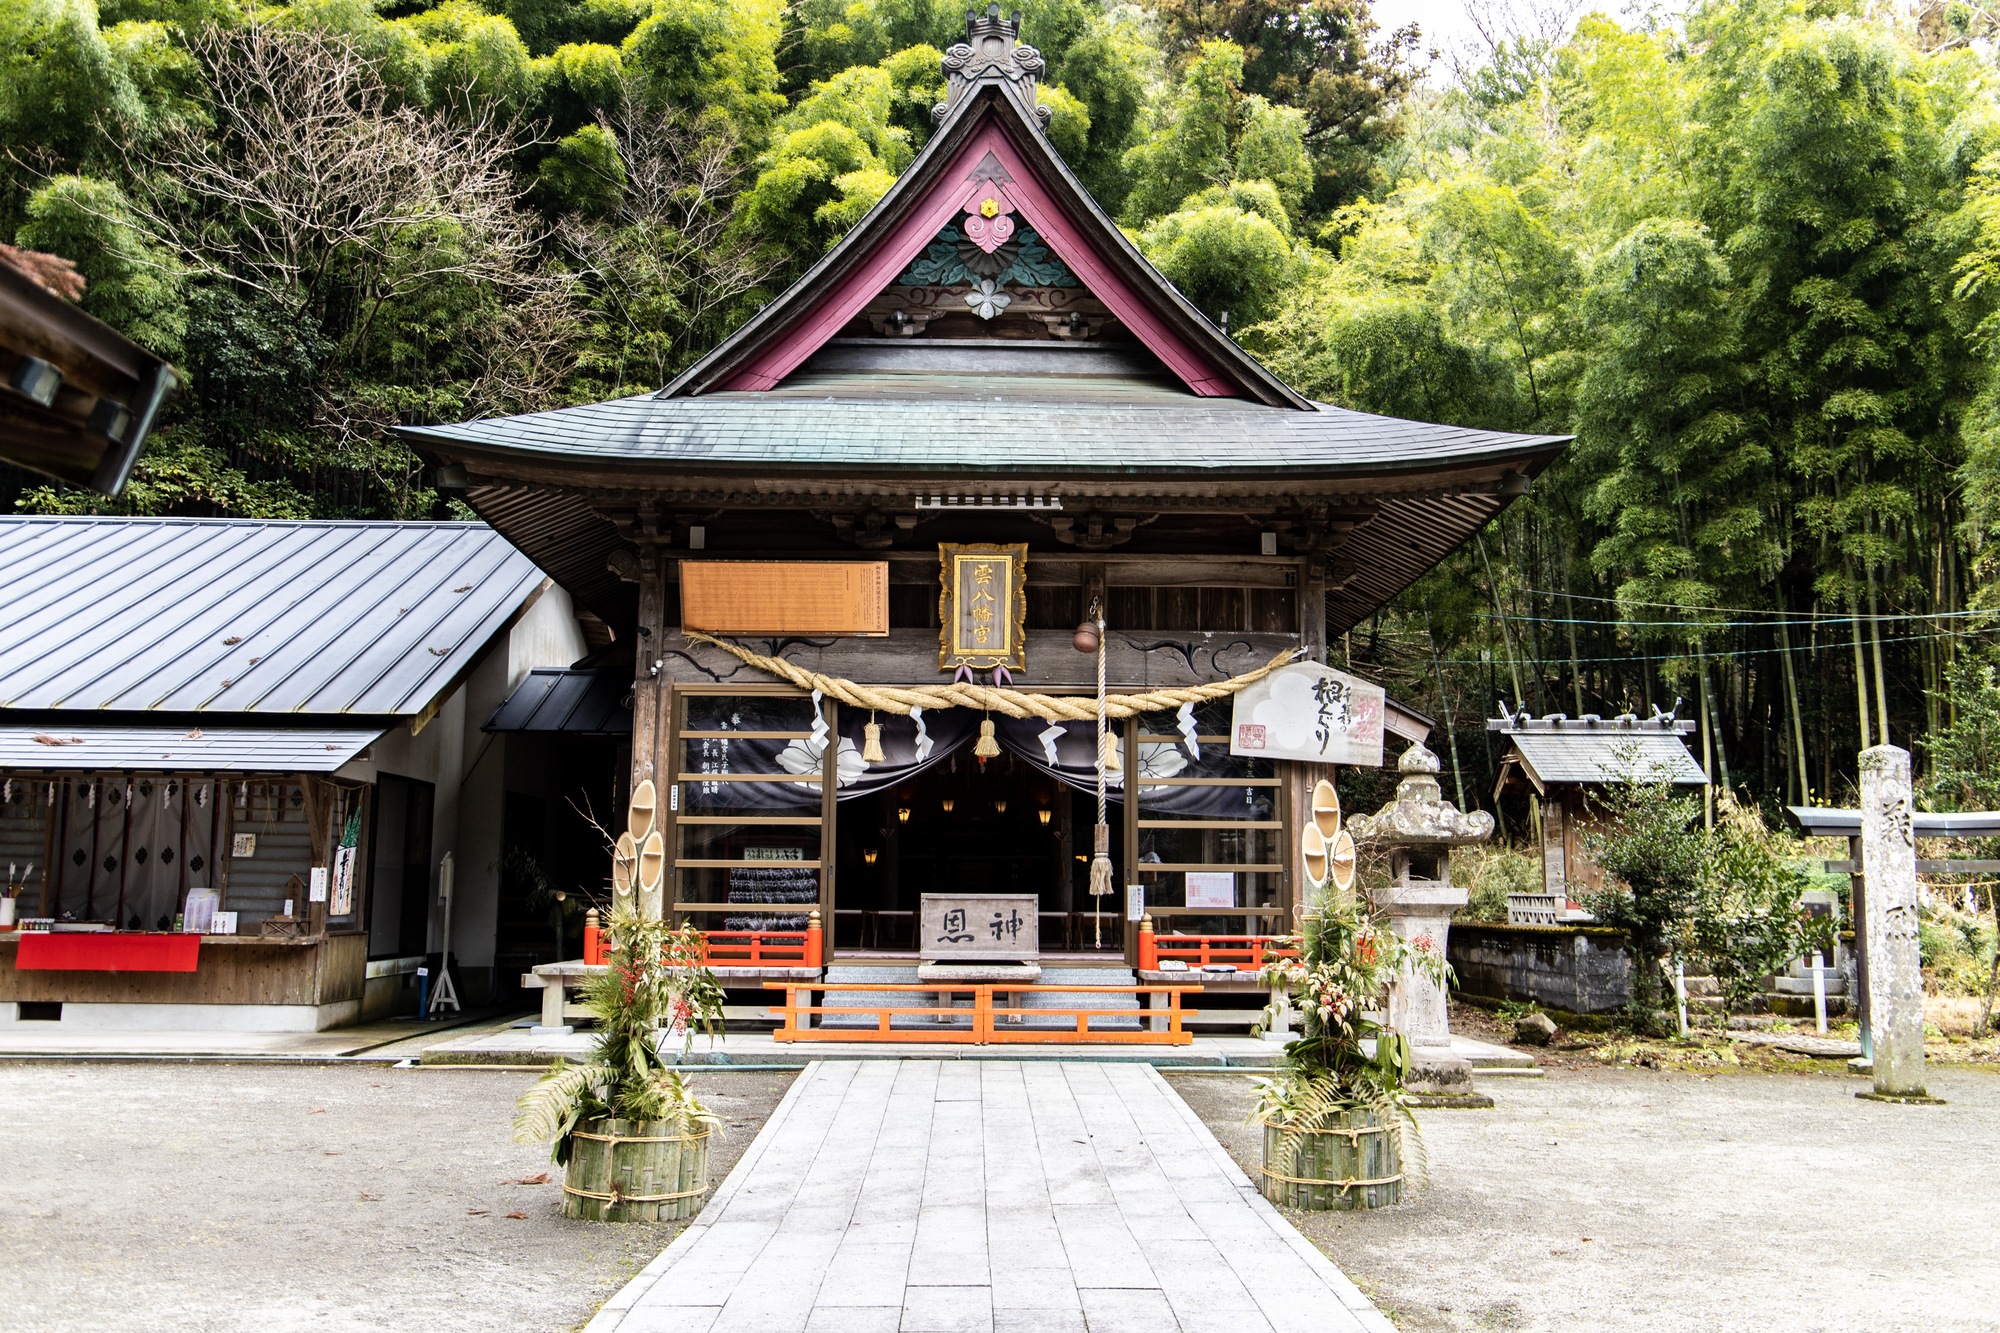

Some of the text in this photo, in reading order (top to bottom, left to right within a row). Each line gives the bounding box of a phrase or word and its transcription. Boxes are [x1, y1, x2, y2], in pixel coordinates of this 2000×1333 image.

[971, 563, 996, 646] 雲八幡宮
[1311, 676, 1345, 757] 根くぐり
